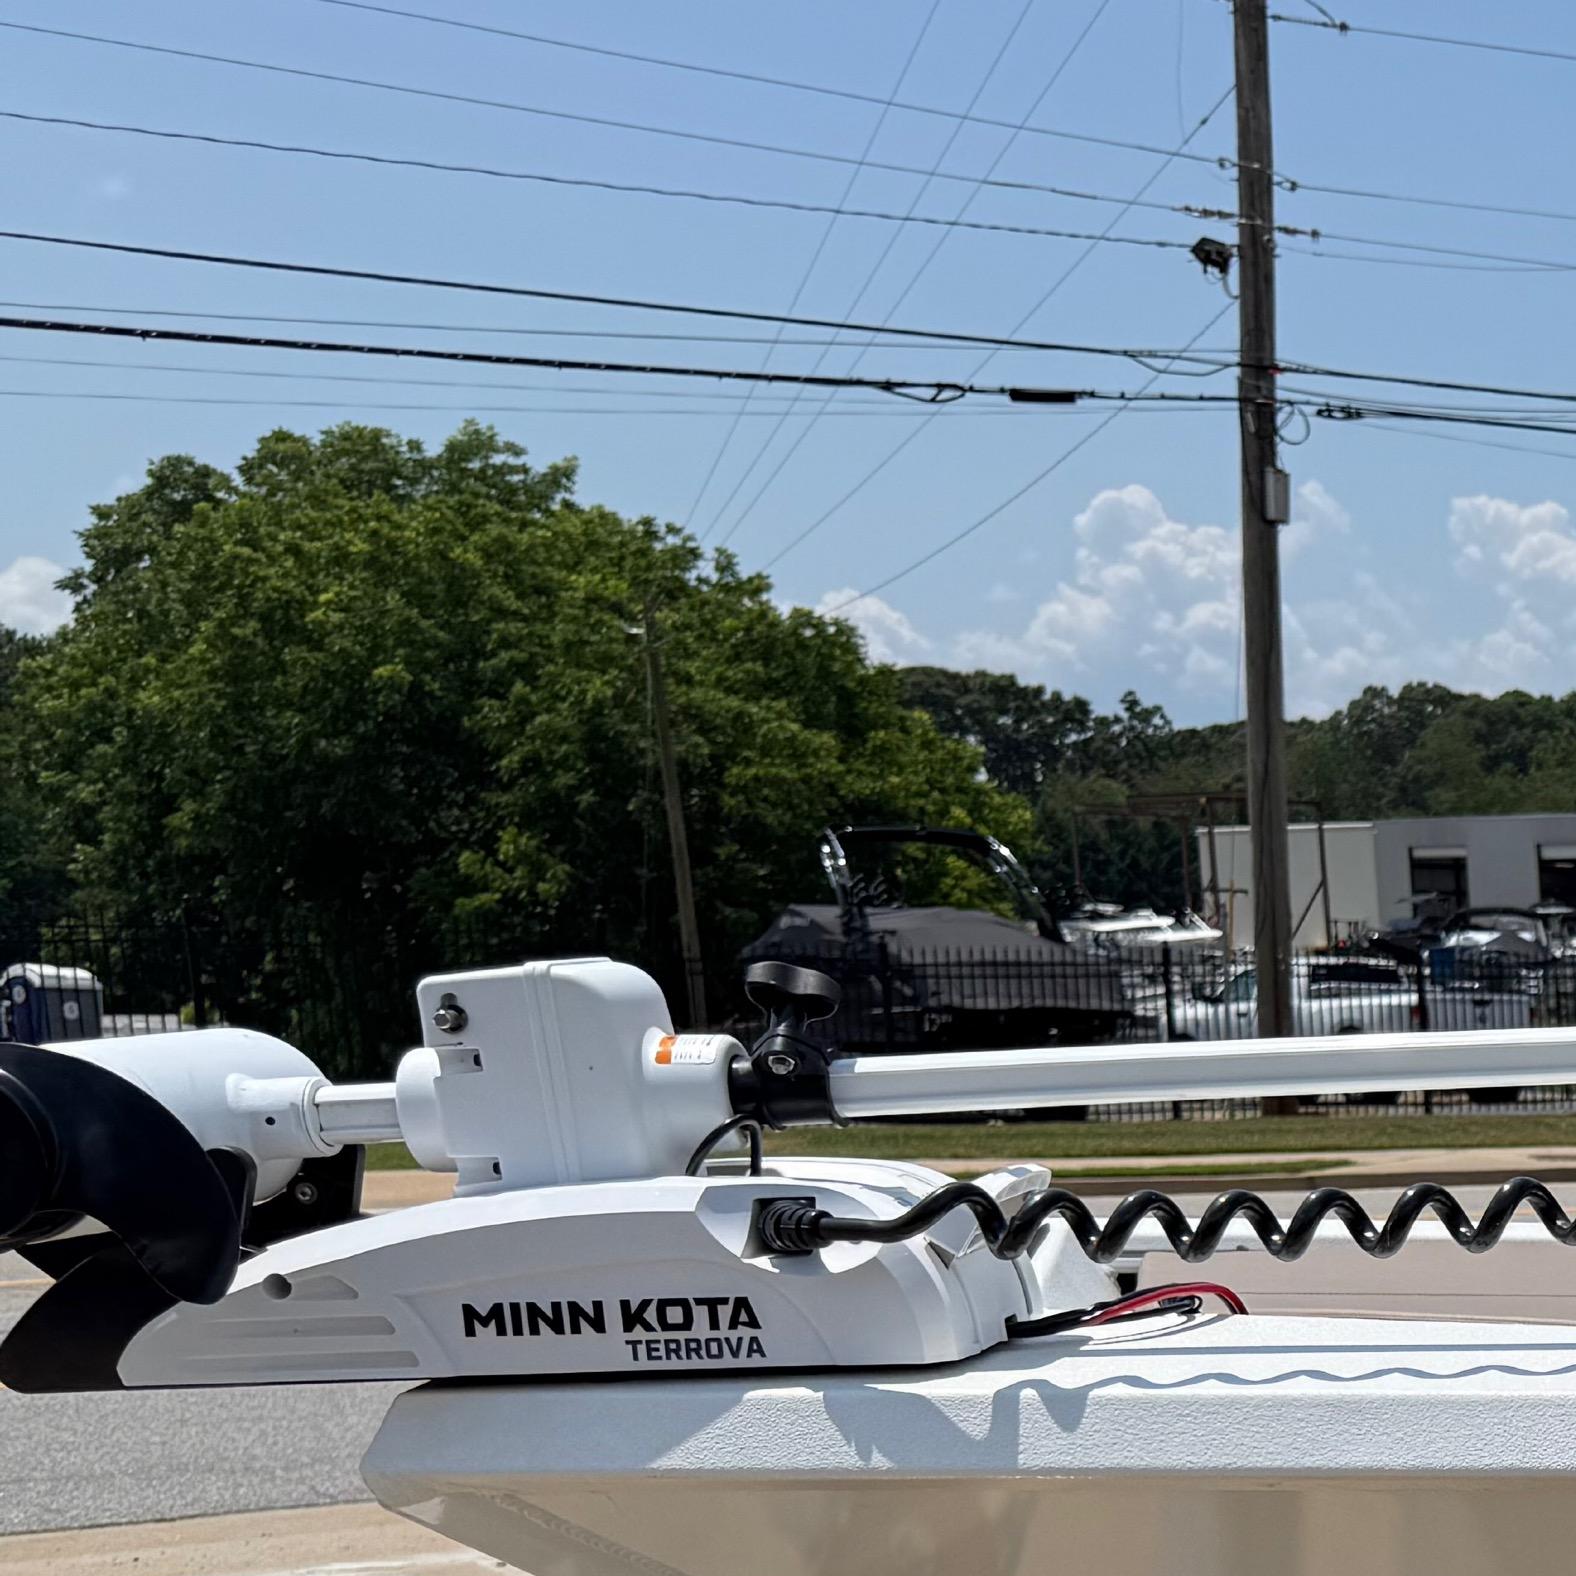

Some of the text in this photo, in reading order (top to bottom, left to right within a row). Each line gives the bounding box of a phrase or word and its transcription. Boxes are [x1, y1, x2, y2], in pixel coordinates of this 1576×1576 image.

[461, 1296, 763, 1337] MINN KOTA
[624, 1335, 768, 1362] TERROVA
